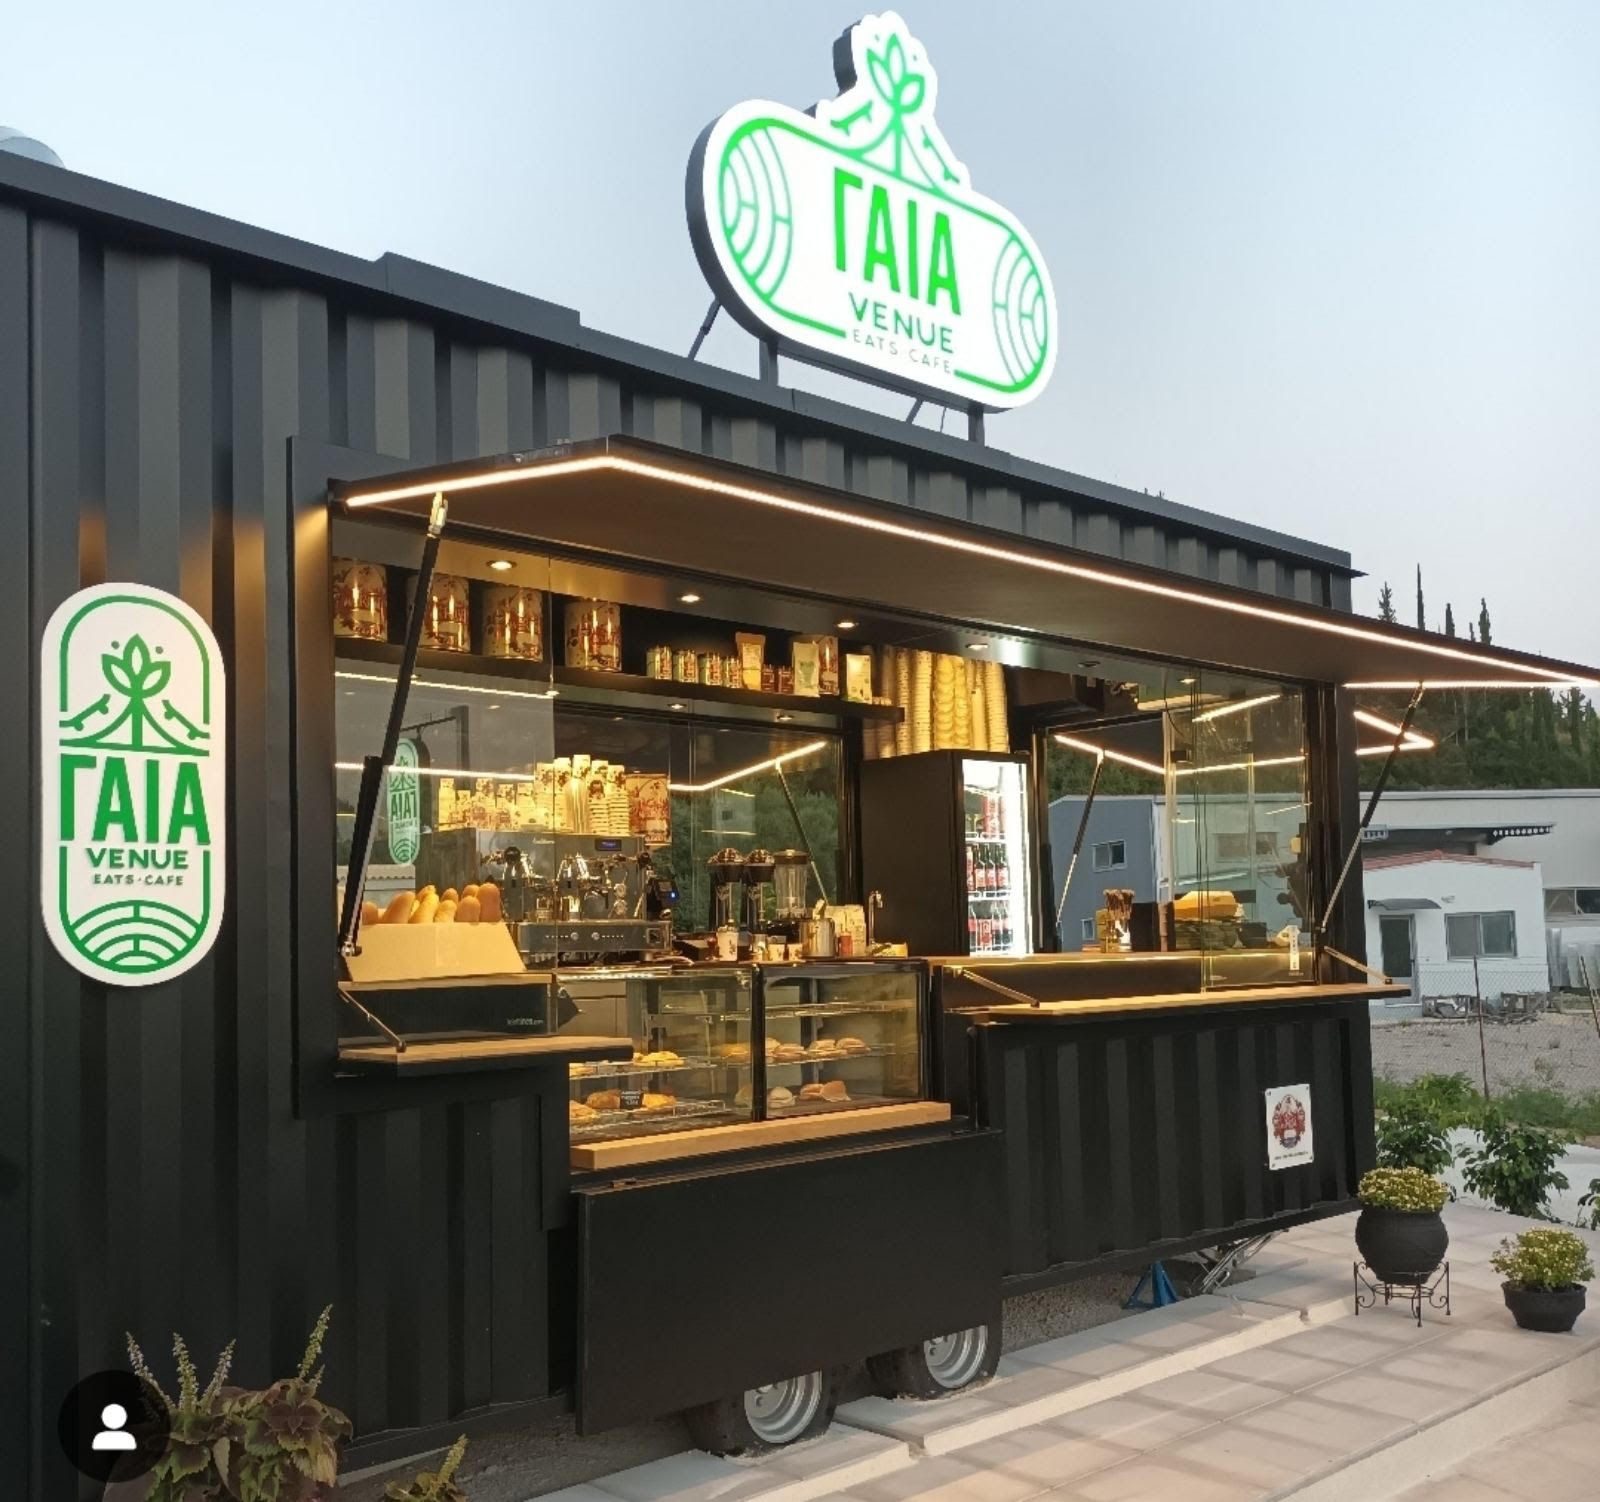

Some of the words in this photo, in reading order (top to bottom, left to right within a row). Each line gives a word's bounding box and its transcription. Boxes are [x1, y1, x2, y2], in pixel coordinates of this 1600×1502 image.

[834, 167, 962, 316] ΓΑΙΑ
[848, 291, 954, 354] VENUE
[852, 328, 898, 356] EATS
[908, 348, 952, 374] CAFE
[60, 753, 211, 846] ΓΑΙΑ
[86, 847, 189, 870] VENUE
[93, 874, 135, 886] EATS
[143, 874, 184, 887] CAFE
